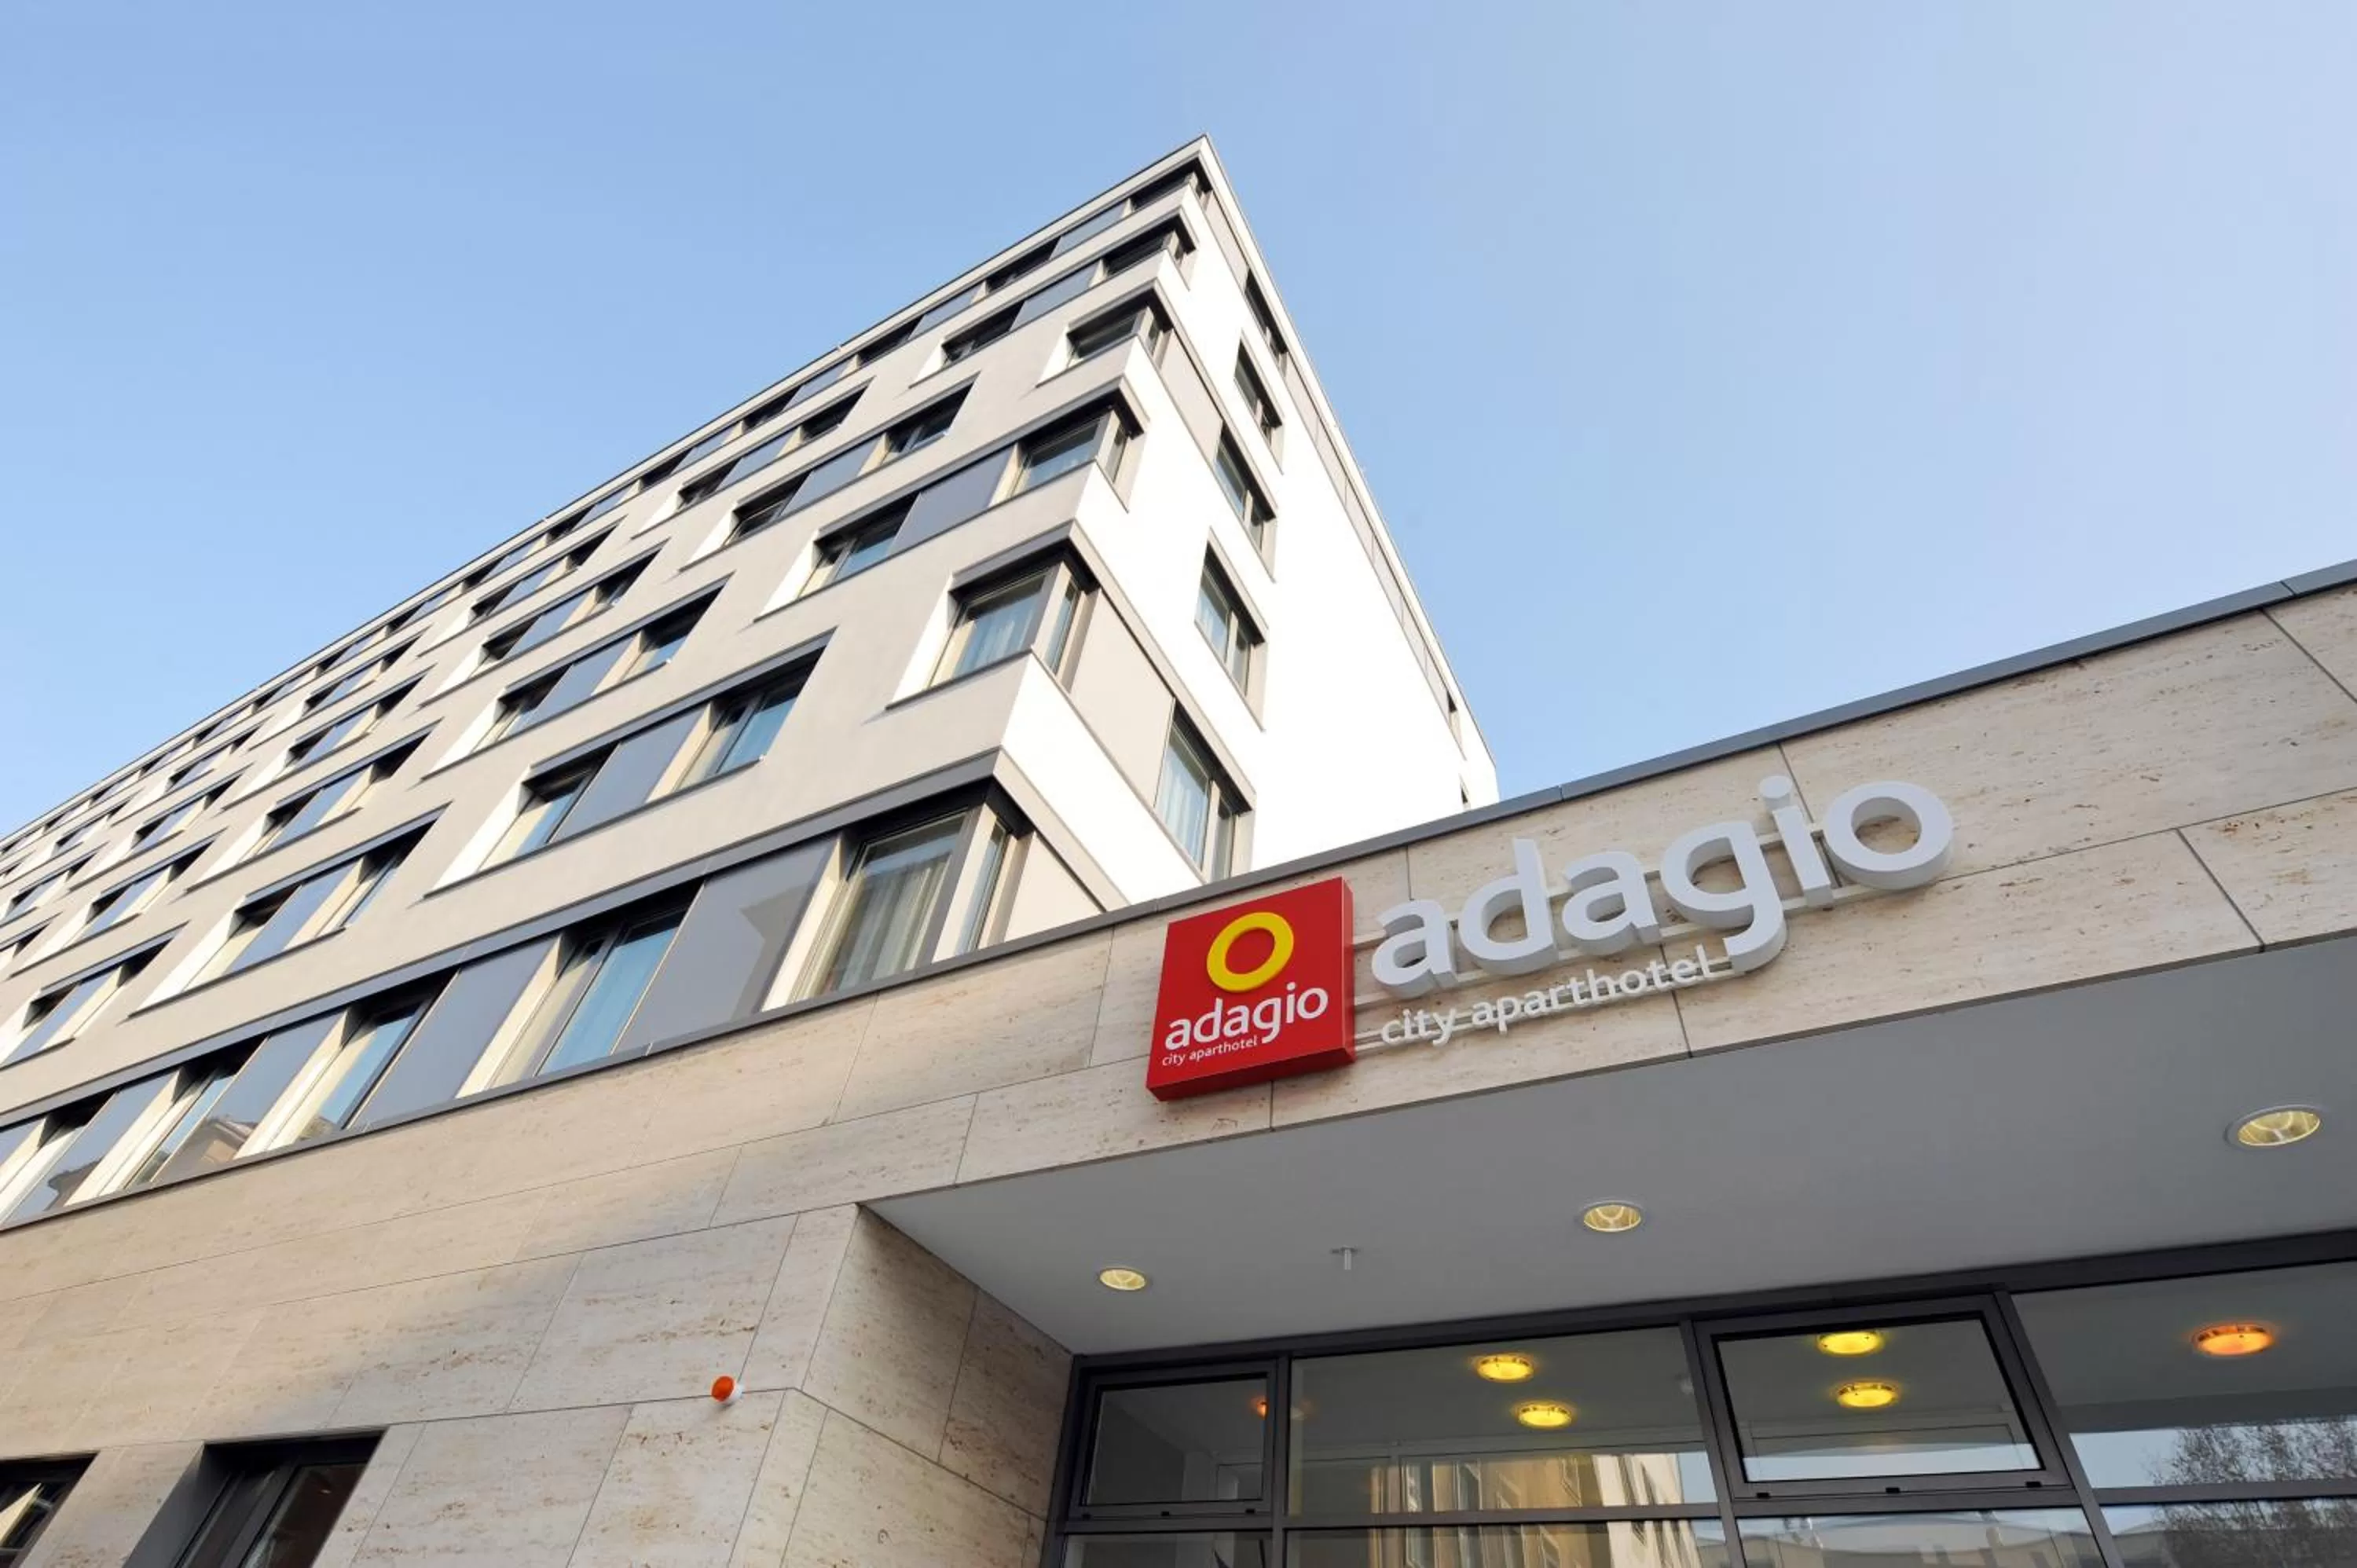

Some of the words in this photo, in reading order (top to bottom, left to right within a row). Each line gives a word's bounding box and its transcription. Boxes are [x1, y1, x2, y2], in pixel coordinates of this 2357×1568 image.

[1372, 775, 1953, 998] adagio
[1164, 982, 1329, 1050] adagio
[1380, 1006, 1459, 1047] city
[1471, 944, 1716, 1035] aparthotel
[1161, 1051, 1187, 1067] city
[1189, 1035, 1259, 1061] aparthotel
